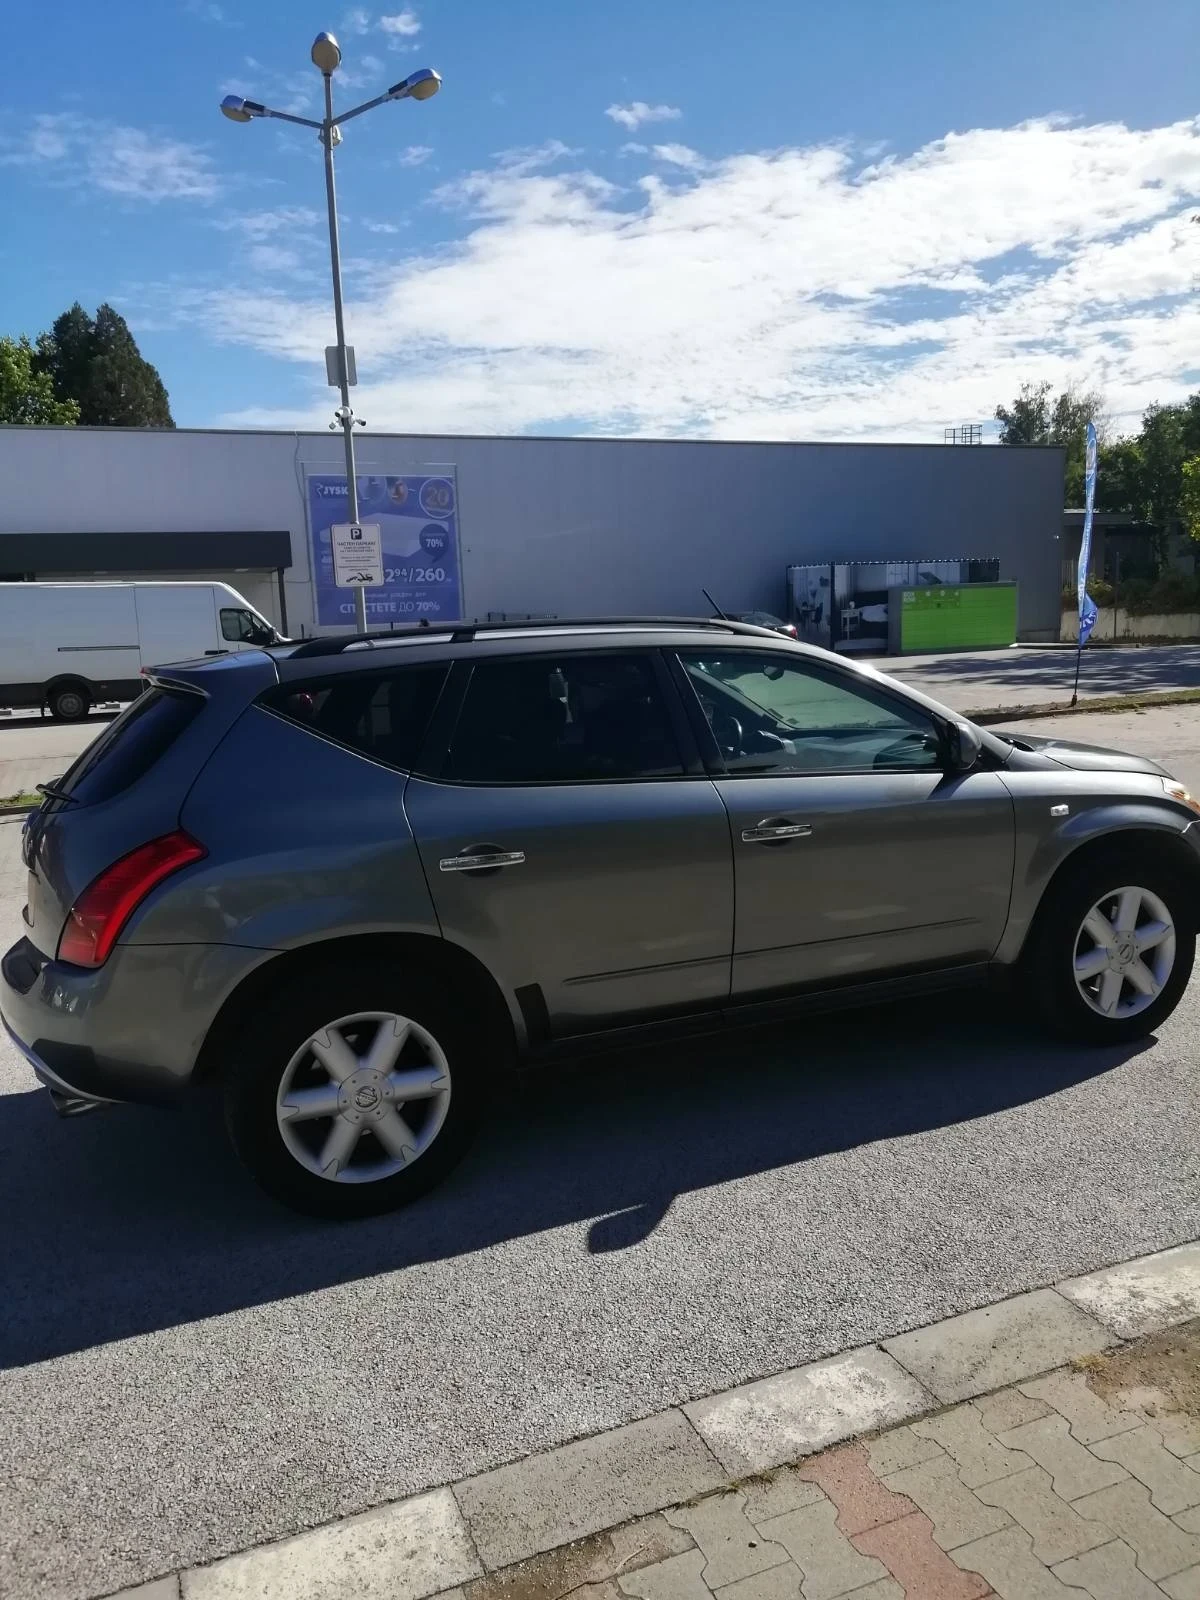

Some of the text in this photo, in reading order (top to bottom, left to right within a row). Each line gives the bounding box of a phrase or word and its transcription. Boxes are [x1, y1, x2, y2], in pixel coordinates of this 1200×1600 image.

[323, 486, 349, 495] JYSK
[425, 538, 444, 548] 70%
[340, 602, 397, 614] СПСТЕТЕ
[415, 601, 440, 612] 70%
